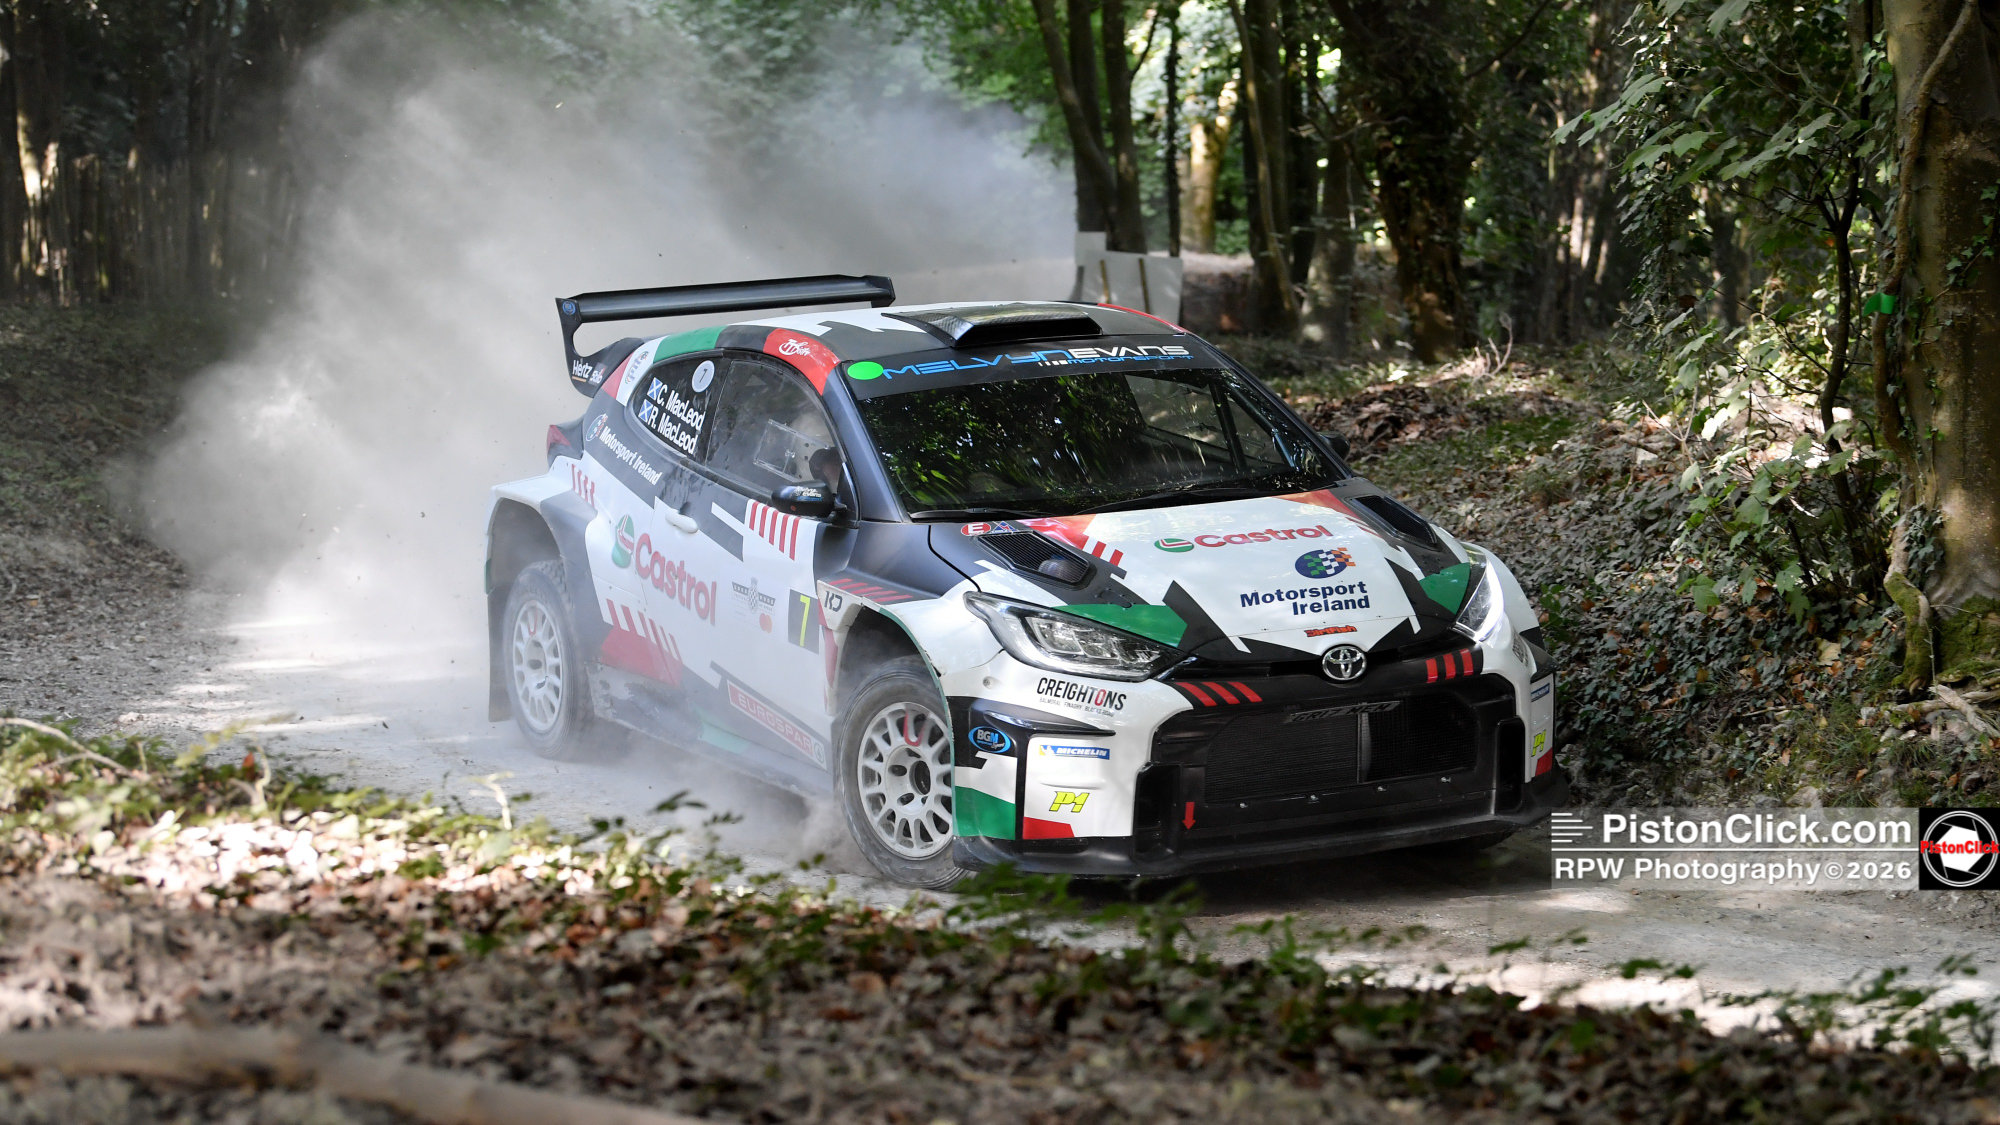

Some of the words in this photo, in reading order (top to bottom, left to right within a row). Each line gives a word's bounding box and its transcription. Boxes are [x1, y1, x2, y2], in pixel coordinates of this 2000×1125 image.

[1068, 346, 1190, 359] EVANS
[572, 360, 593, 379] Hertz
[657, 384, 668, 406] C.
[665, 390, 706, 431] MacLeod
[647, 405, 659, 429] R.
[657, 412, 698, 454] MacLeod
[599, 425, 638, 466] Motorsport
[632, 455, 663, 486] Ireland
[1194, 525, 1334, 547] Castrol
[635, 533, 717, 626] Castrol
[1240, 581, 1368, 607] Motorsport
[1292, 595, 1370, 615] Ireland
[800, 594, 810, 647] 7
[1037, 677, 1127, 711] CREIGHTONS
[977, 729, 999, 743] BGM
[1056, 748, 1108, 756] MICHELIN
[1049, 791, 1090, 813] P1
